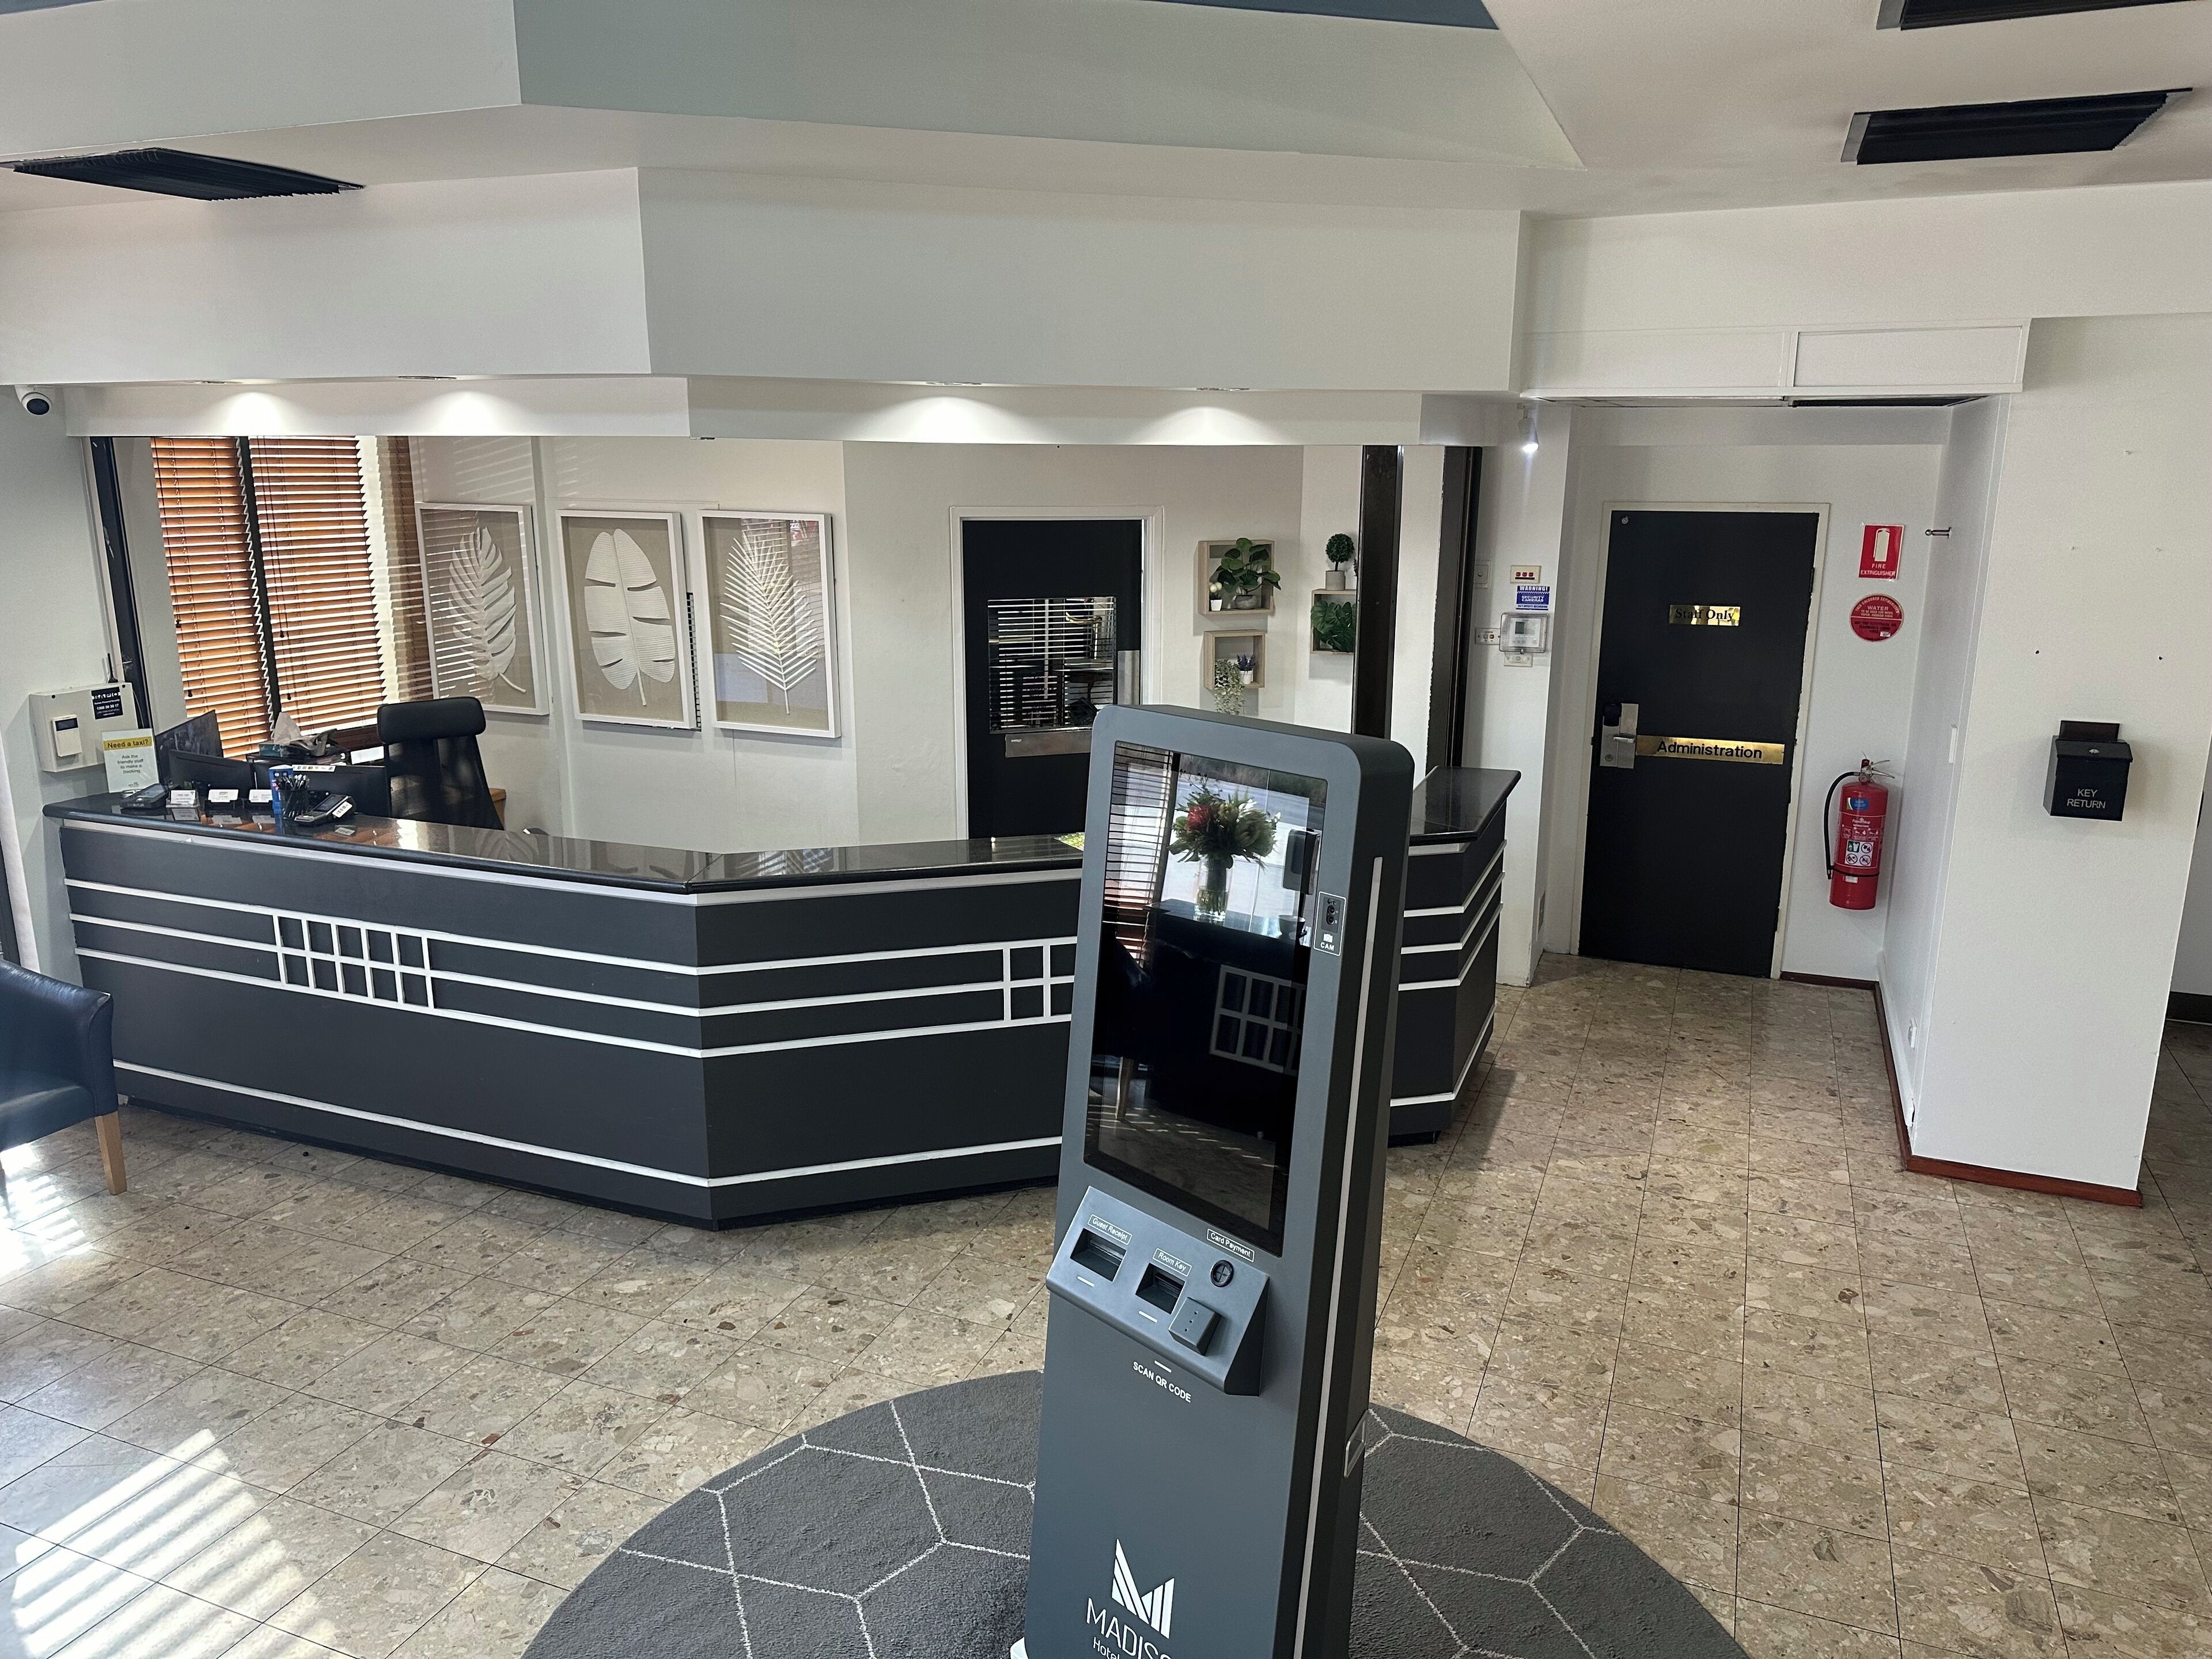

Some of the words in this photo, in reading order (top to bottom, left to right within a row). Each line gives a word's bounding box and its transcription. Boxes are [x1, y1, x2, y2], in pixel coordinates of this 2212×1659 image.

[1675, 608, 1704, 619] Staff
[1706, 609, 1734, 622] Only
[1656, 741, 1762, 759] Administration
[2077, 789, 2098, 797] KEY
[2067, 798, 2106, 809] RETURN
[1320, 942, 1335, 950] CAM
[1092, 1218, 1108, 1230] Guest
[1107, 1225, 1128, 1241] Receipt
[1211, 1232, 1225, 1244] Card
[1225, 1239, 1251, 1257] Payment
[1158, 1252, 1175, 1266] Room
[1175, 1260, 1187, 1272] Key
[1132, 1361, 1154, 1381] SCAN
[1156, 1375, 1168, 1389] QR
[1168, 1383, 1192, 1403] CODE
[1086, 1597, 1172, 1659] MADIS
